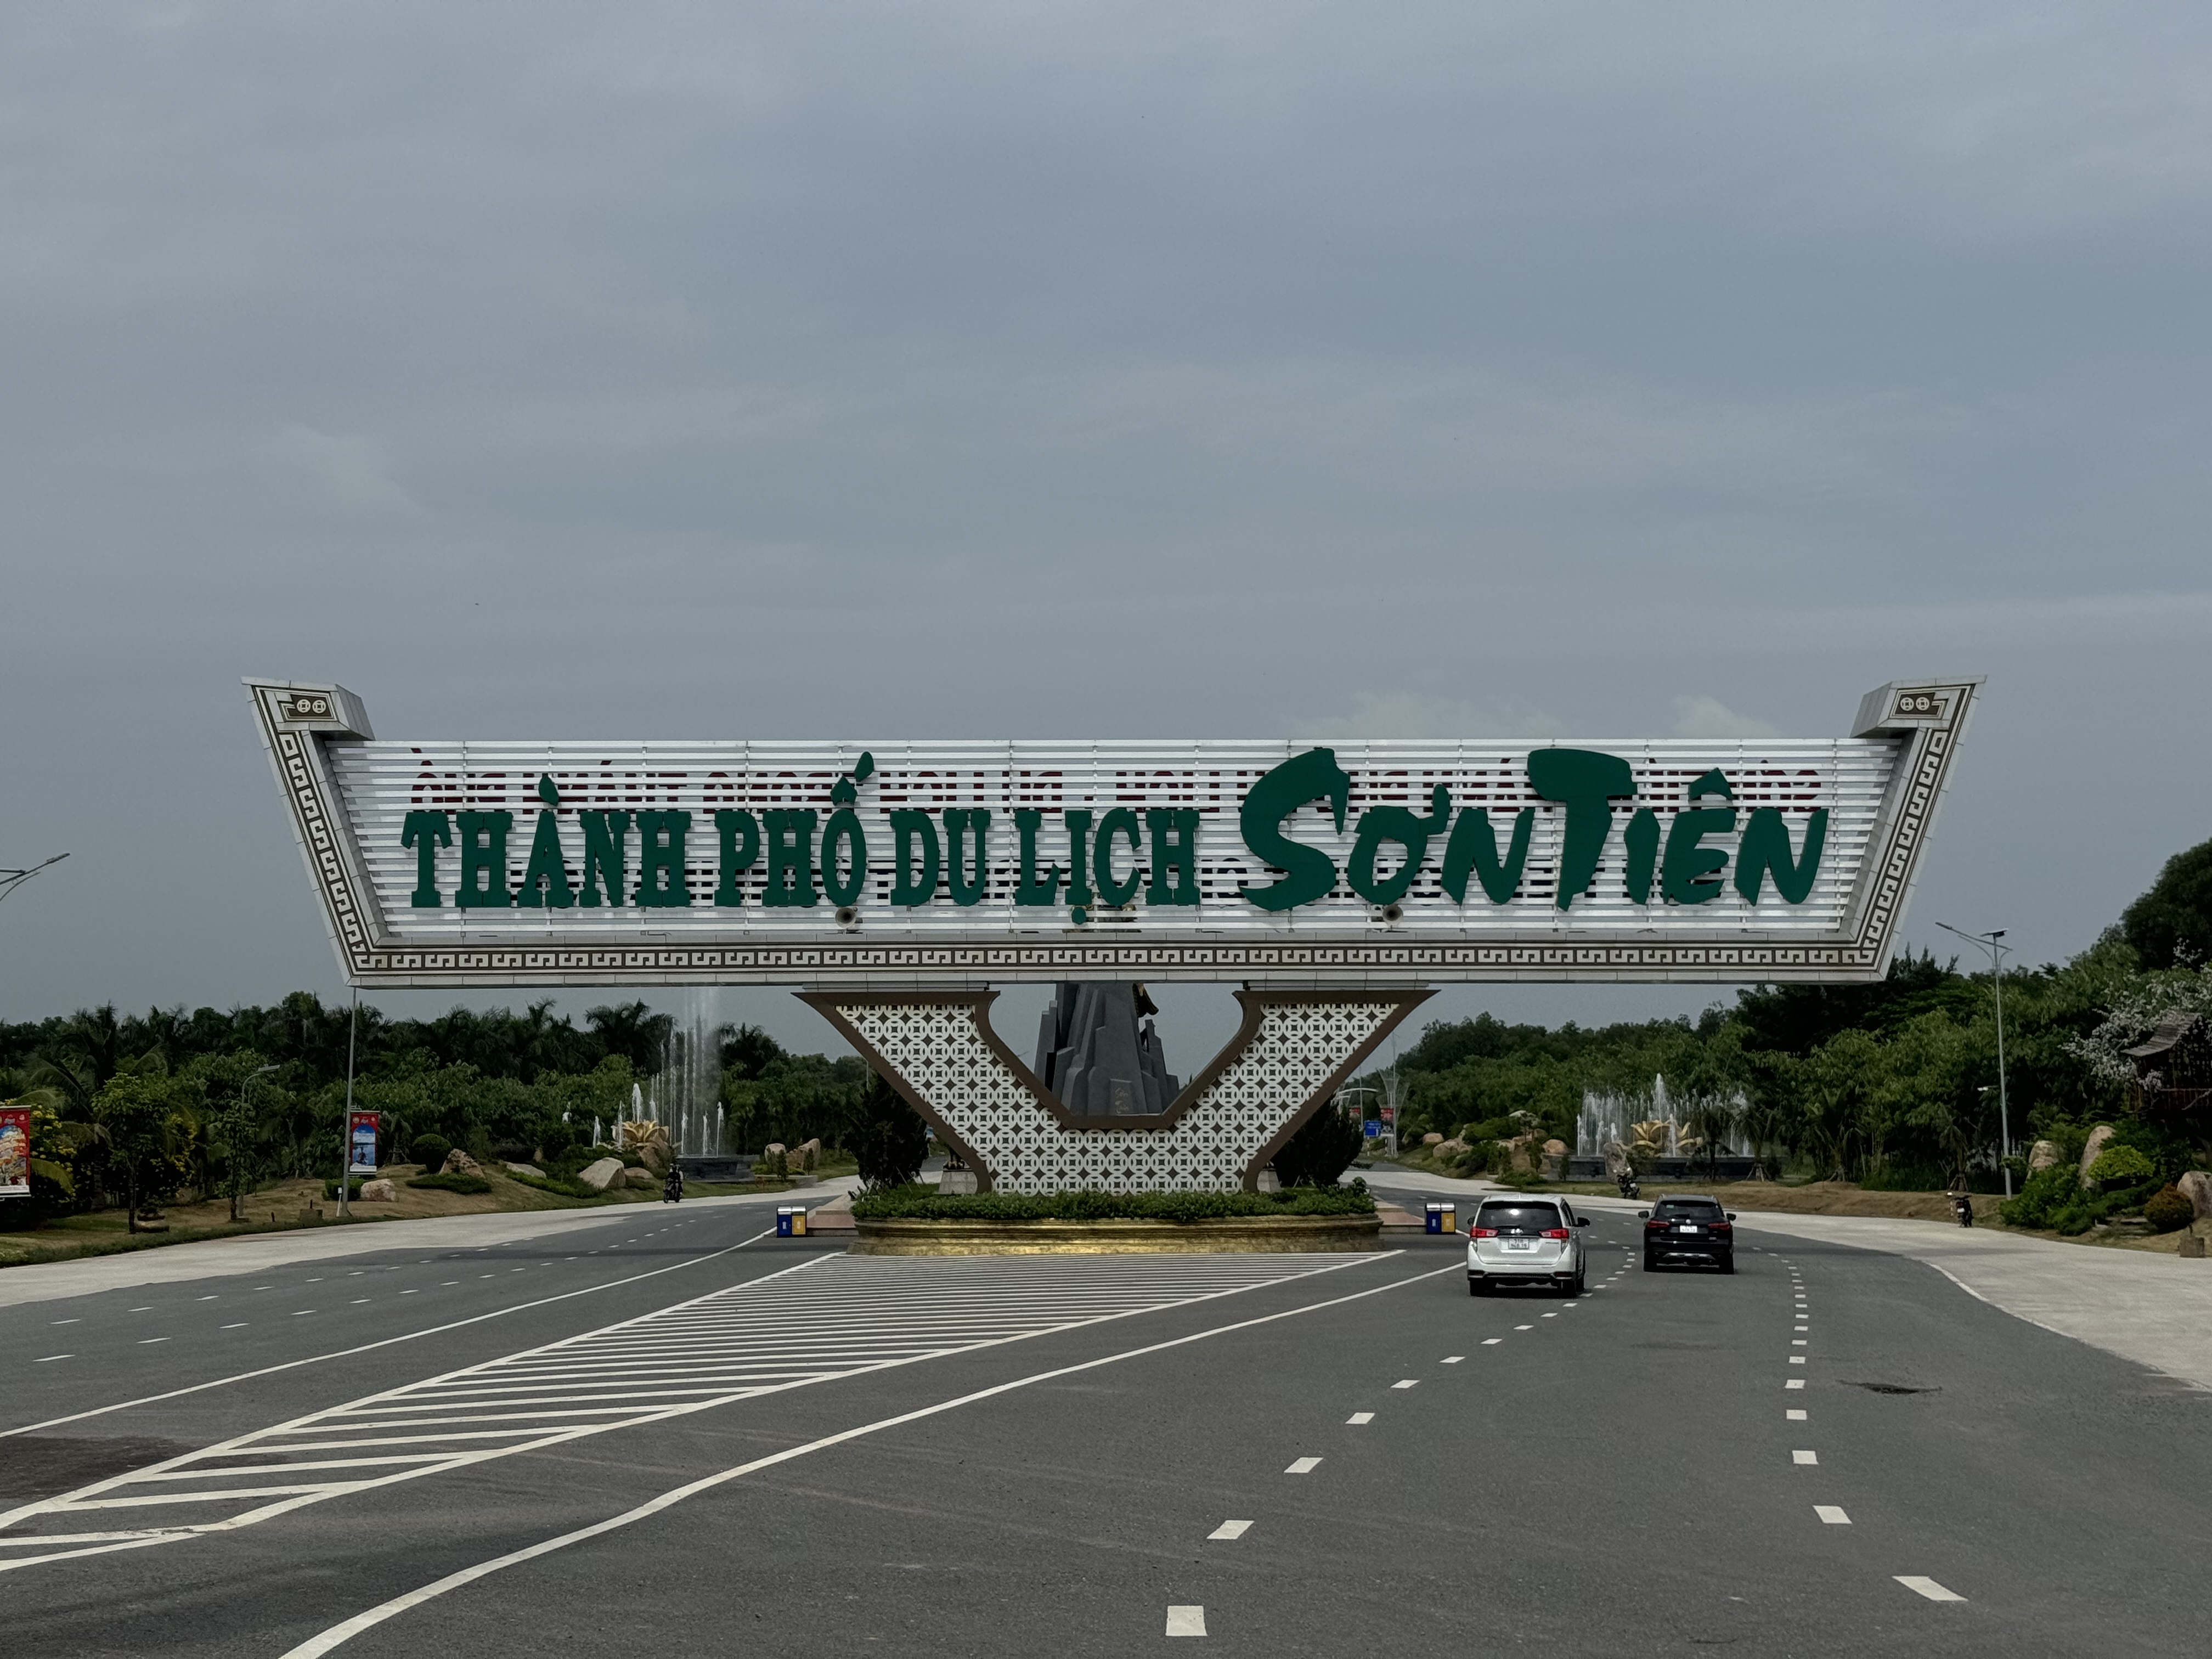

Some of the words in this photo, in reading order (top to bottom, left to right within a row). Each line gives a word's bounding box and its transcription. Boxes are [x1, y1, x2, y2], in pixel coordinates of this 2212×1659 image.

[401, 775, 692, 909] THÀNH
[714, 751, 874, 907] PHỐ
[889, 809, 992, 907] DU
[1013, 808, 1201, 925] LỊCH
[1527, 748, 1829, 912] TIÊN
